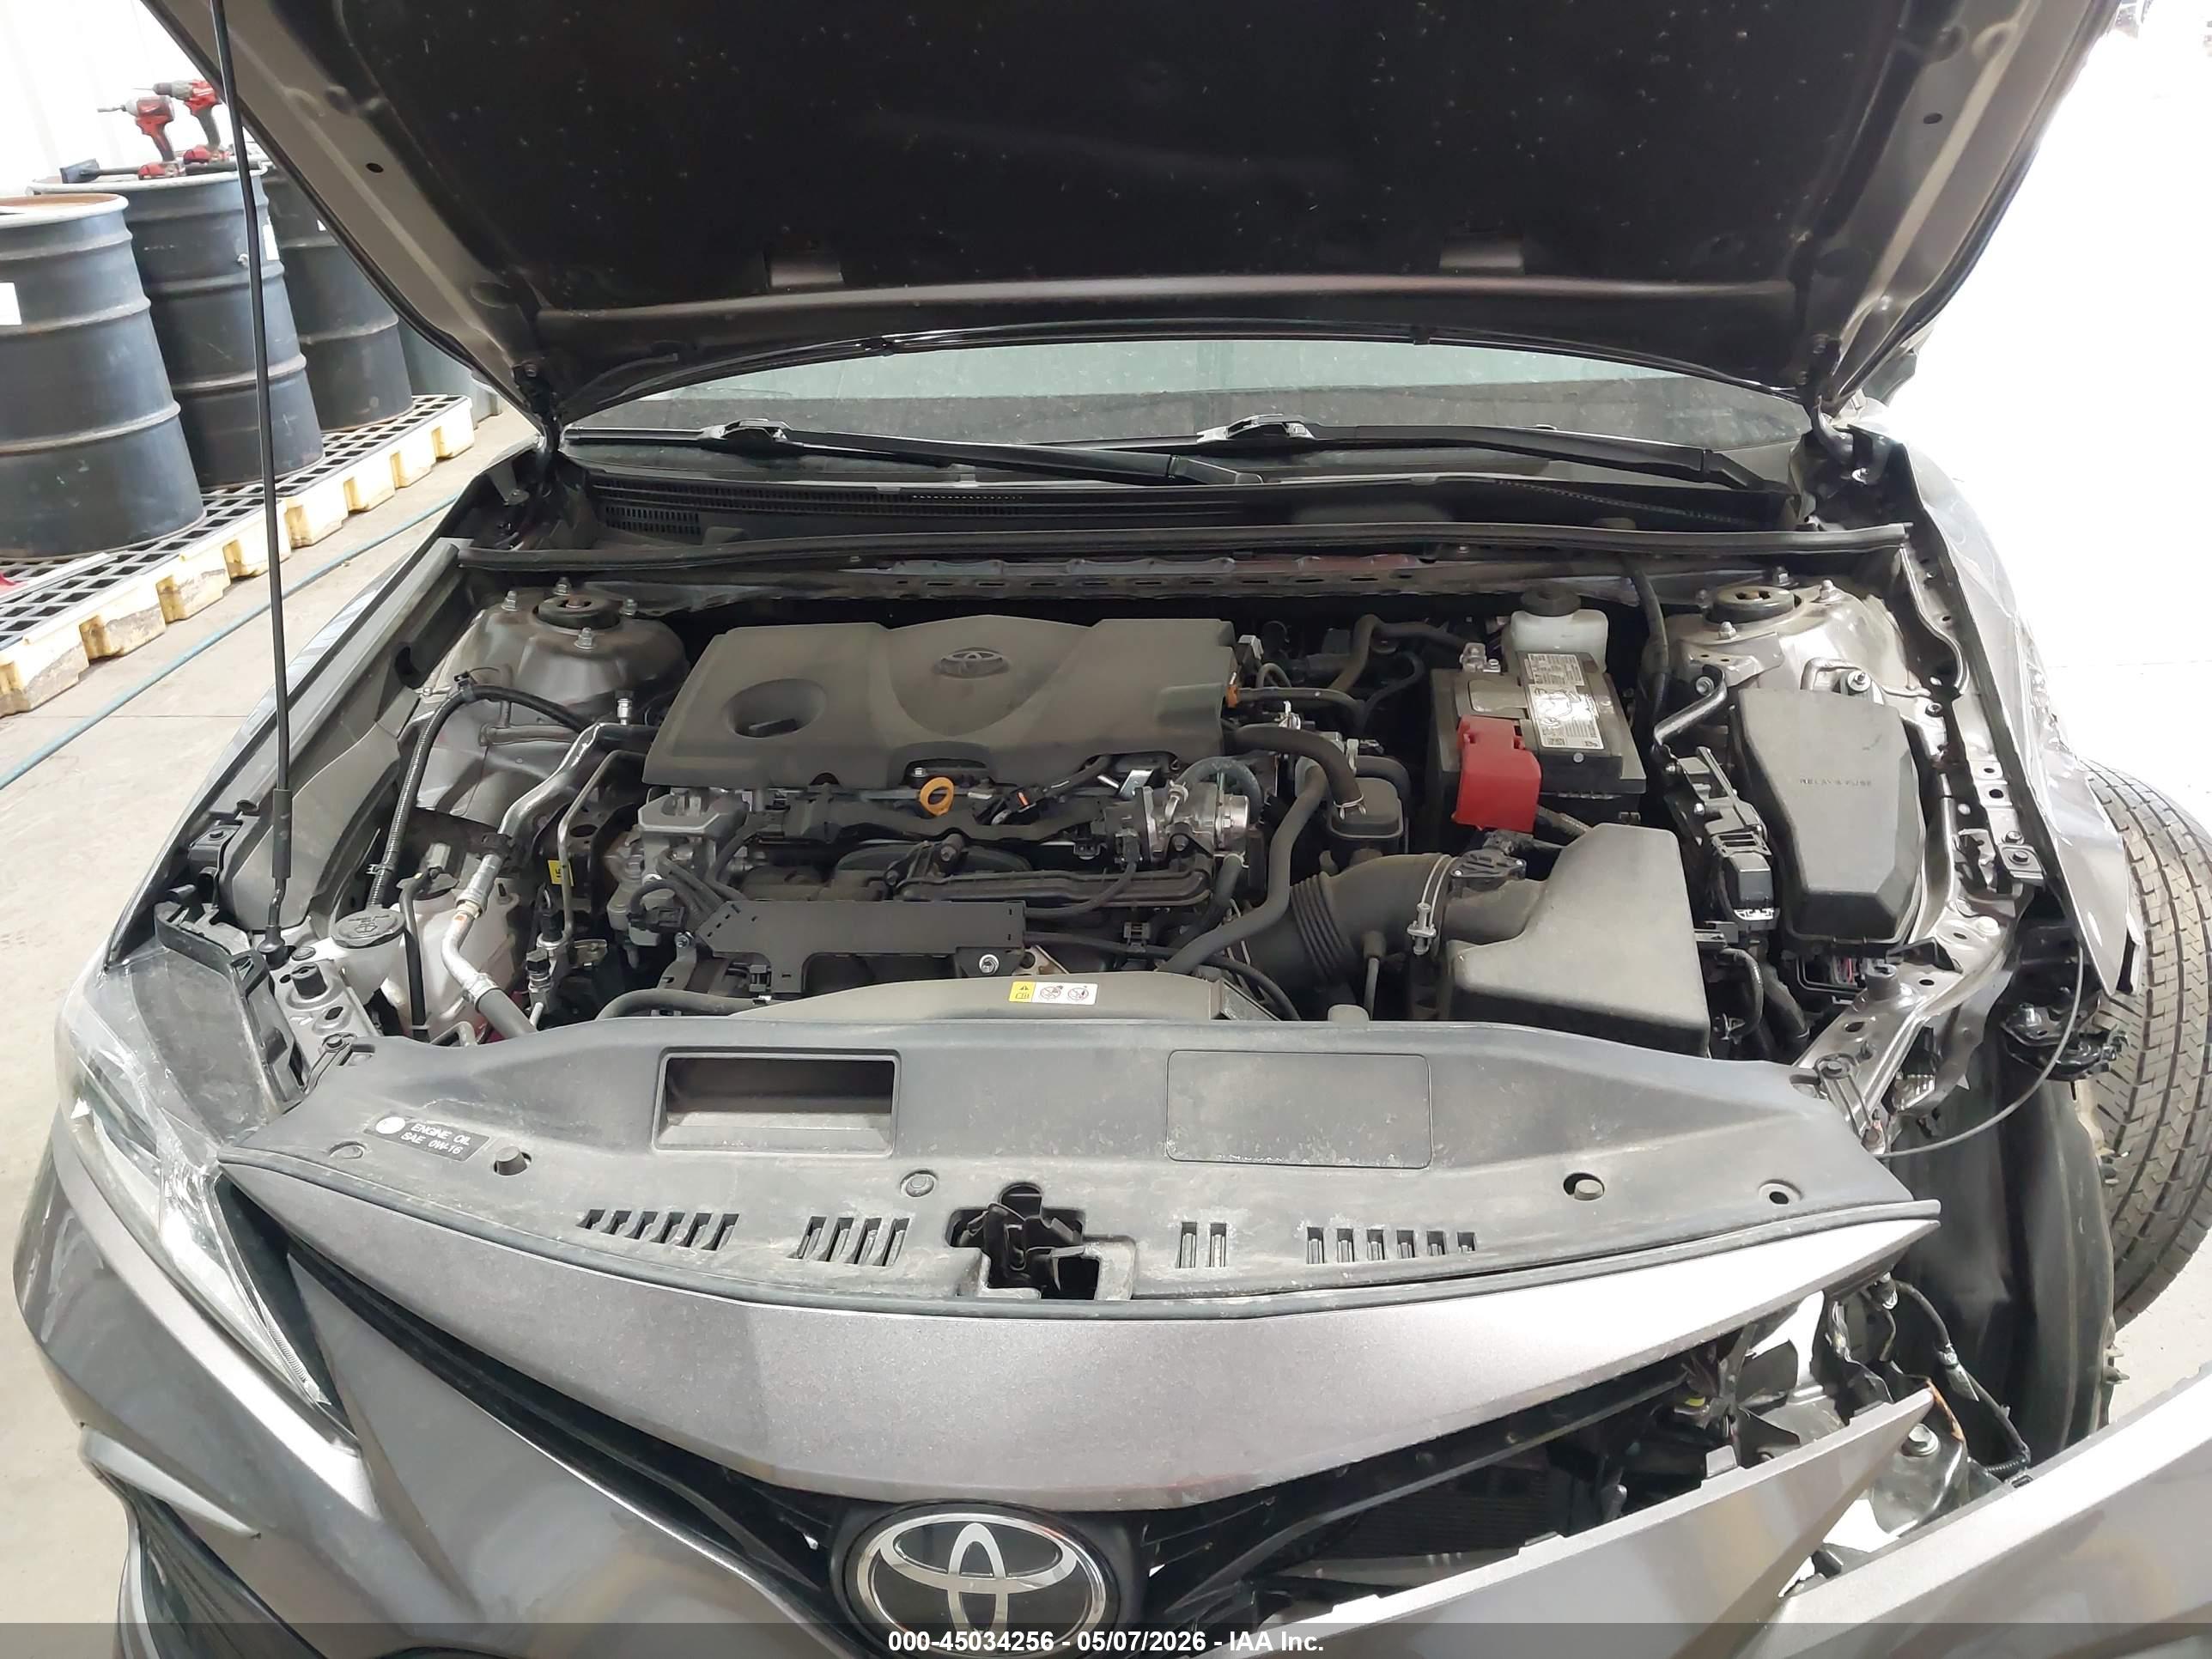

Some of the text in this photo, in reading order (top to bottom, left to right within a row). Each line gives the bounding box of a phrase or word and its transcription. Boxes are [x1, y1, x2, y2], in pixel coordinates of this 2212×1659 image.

[400, 1132, 463, 1154] SAE 0W-16
[410, 1123, 471, 1146] ENGINE OIL
